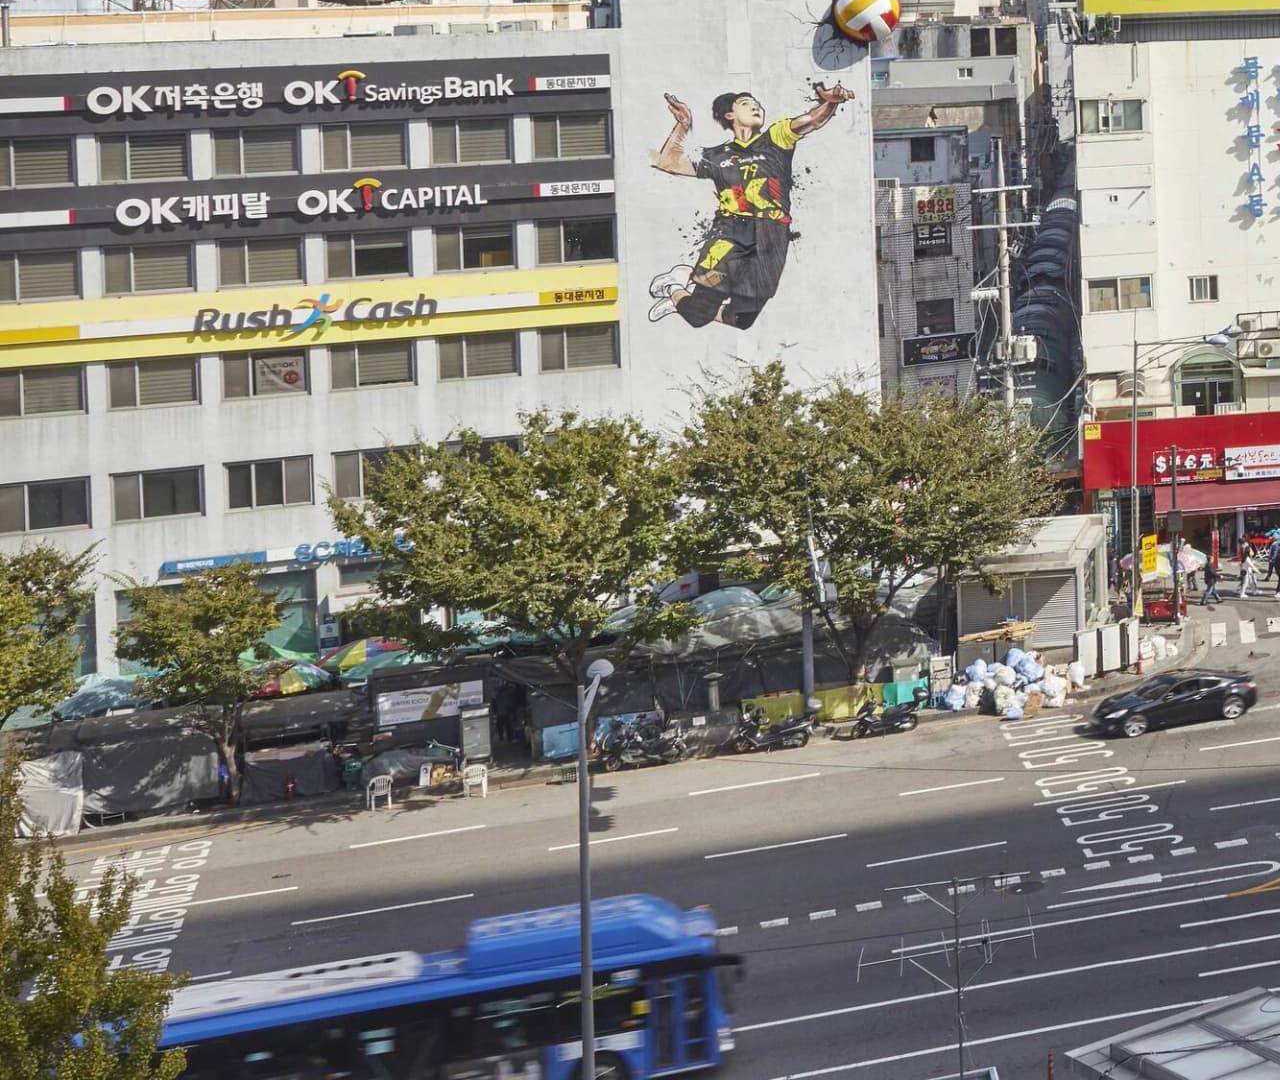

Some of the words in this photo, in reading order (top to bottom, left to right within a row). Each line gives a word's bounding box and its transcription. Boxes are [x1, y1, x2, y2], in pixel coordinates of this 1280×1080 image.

[546, 76, 596, 88] 동대문지점
[739, 163, 759, 180] 79
[550, 181, 601, 195] 동대문지점
[381, 184, 488, 210] CAPITAL
[554, 289, 605, 302] 동대문지점
[193, 305, 293, 336] Rush
[345, 293, 438, 323] Cash
